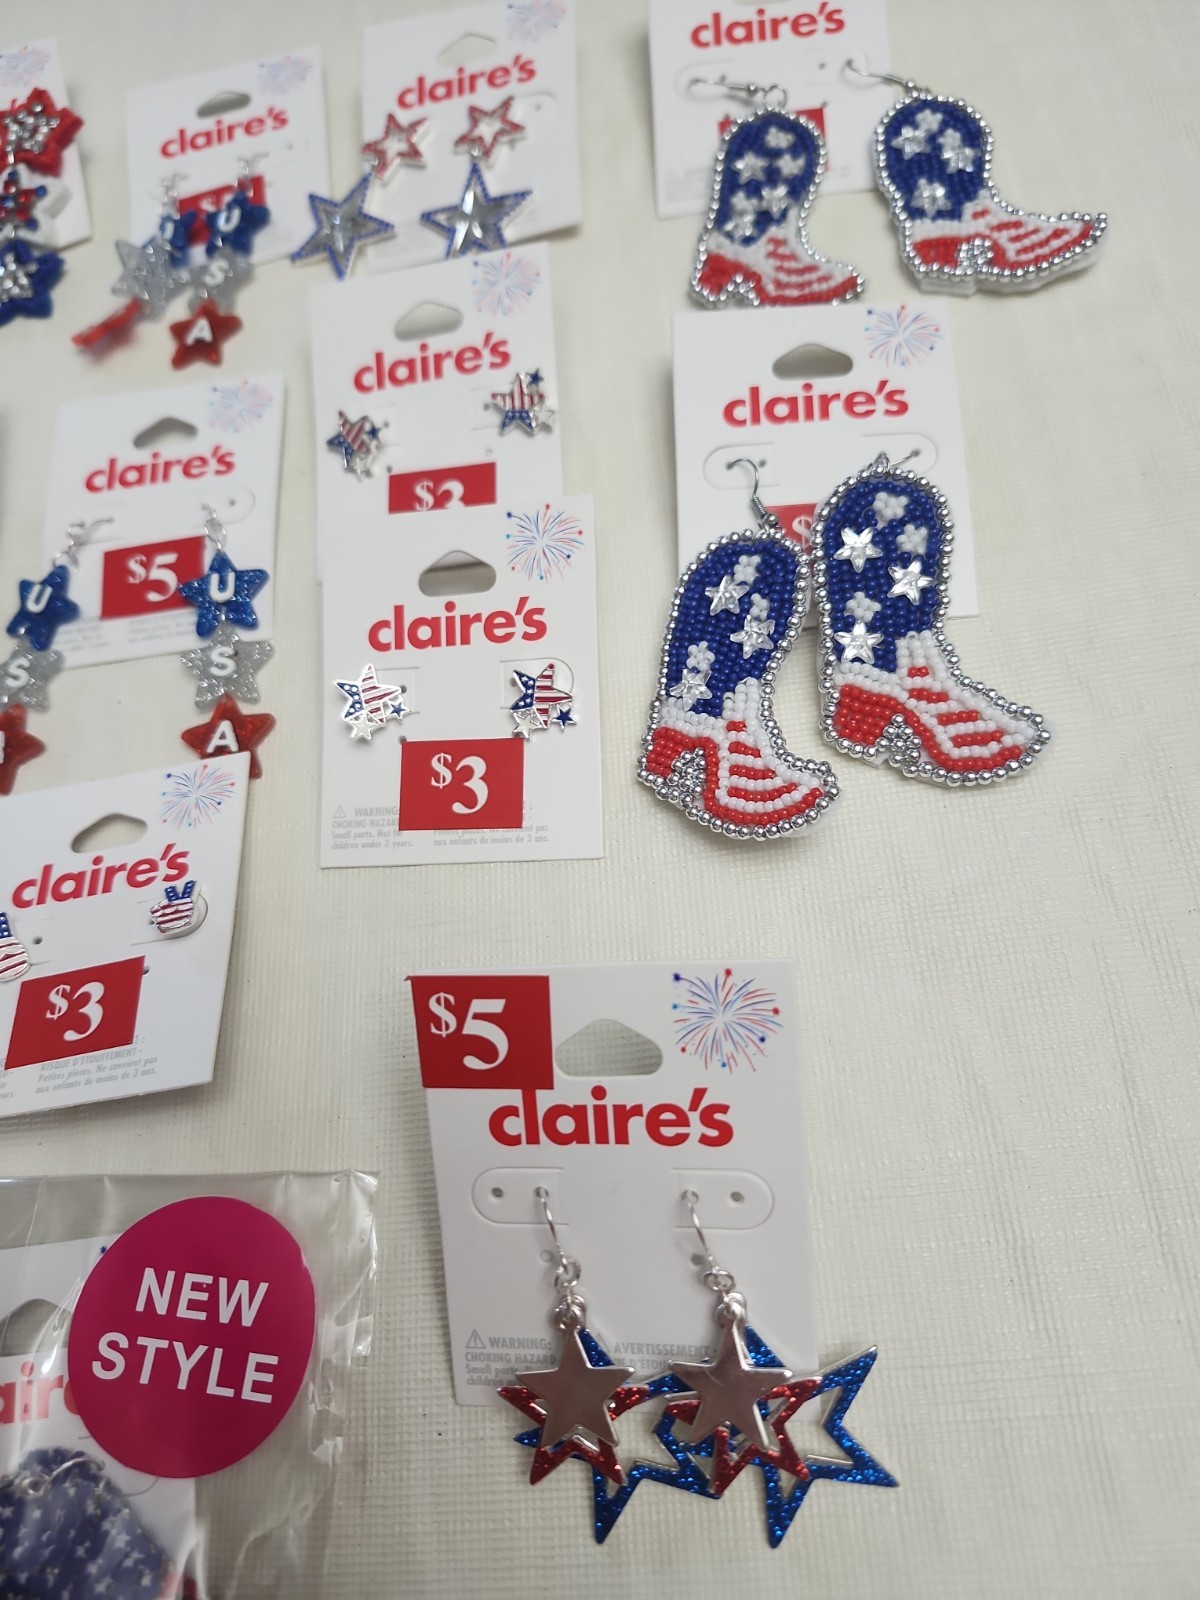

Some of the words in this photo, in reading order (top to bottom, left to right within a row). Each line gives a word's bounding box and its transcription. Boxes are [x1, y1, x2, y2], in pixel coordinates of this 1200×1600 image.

[690, 2, 847, 50] claire's
[397, 54, 538, 111] claire's
[160, 107, 289, 159] claire's
[353, 332, 511, 394] claire's
[722, 379, 910, 428] claire's
[84, 445, 237, 494] claire's
[126, 552, 179, 603] $5
[209, 571, 236, 604] U
[368, 597, 548, 653] claire's
[430, 751, 490, 815] $3
[11, 843, 190, 909] claire's
[45, 981, 105, 1042] $3
[428, 992, 509, 1070] $5
[488, 1085, 735, 1148] claire's
[135, 1267, 270, 1327] NEW
[91, 1332, 280, 1404] STYLE
[464, 1351, 512, 1364] CHOKING
[514, 1353, 557, 1365] HAZARD
[488, 1336, 553, 1351] WARNING:
[613, 1341, 711, 1357] AVERTISSEMENT
